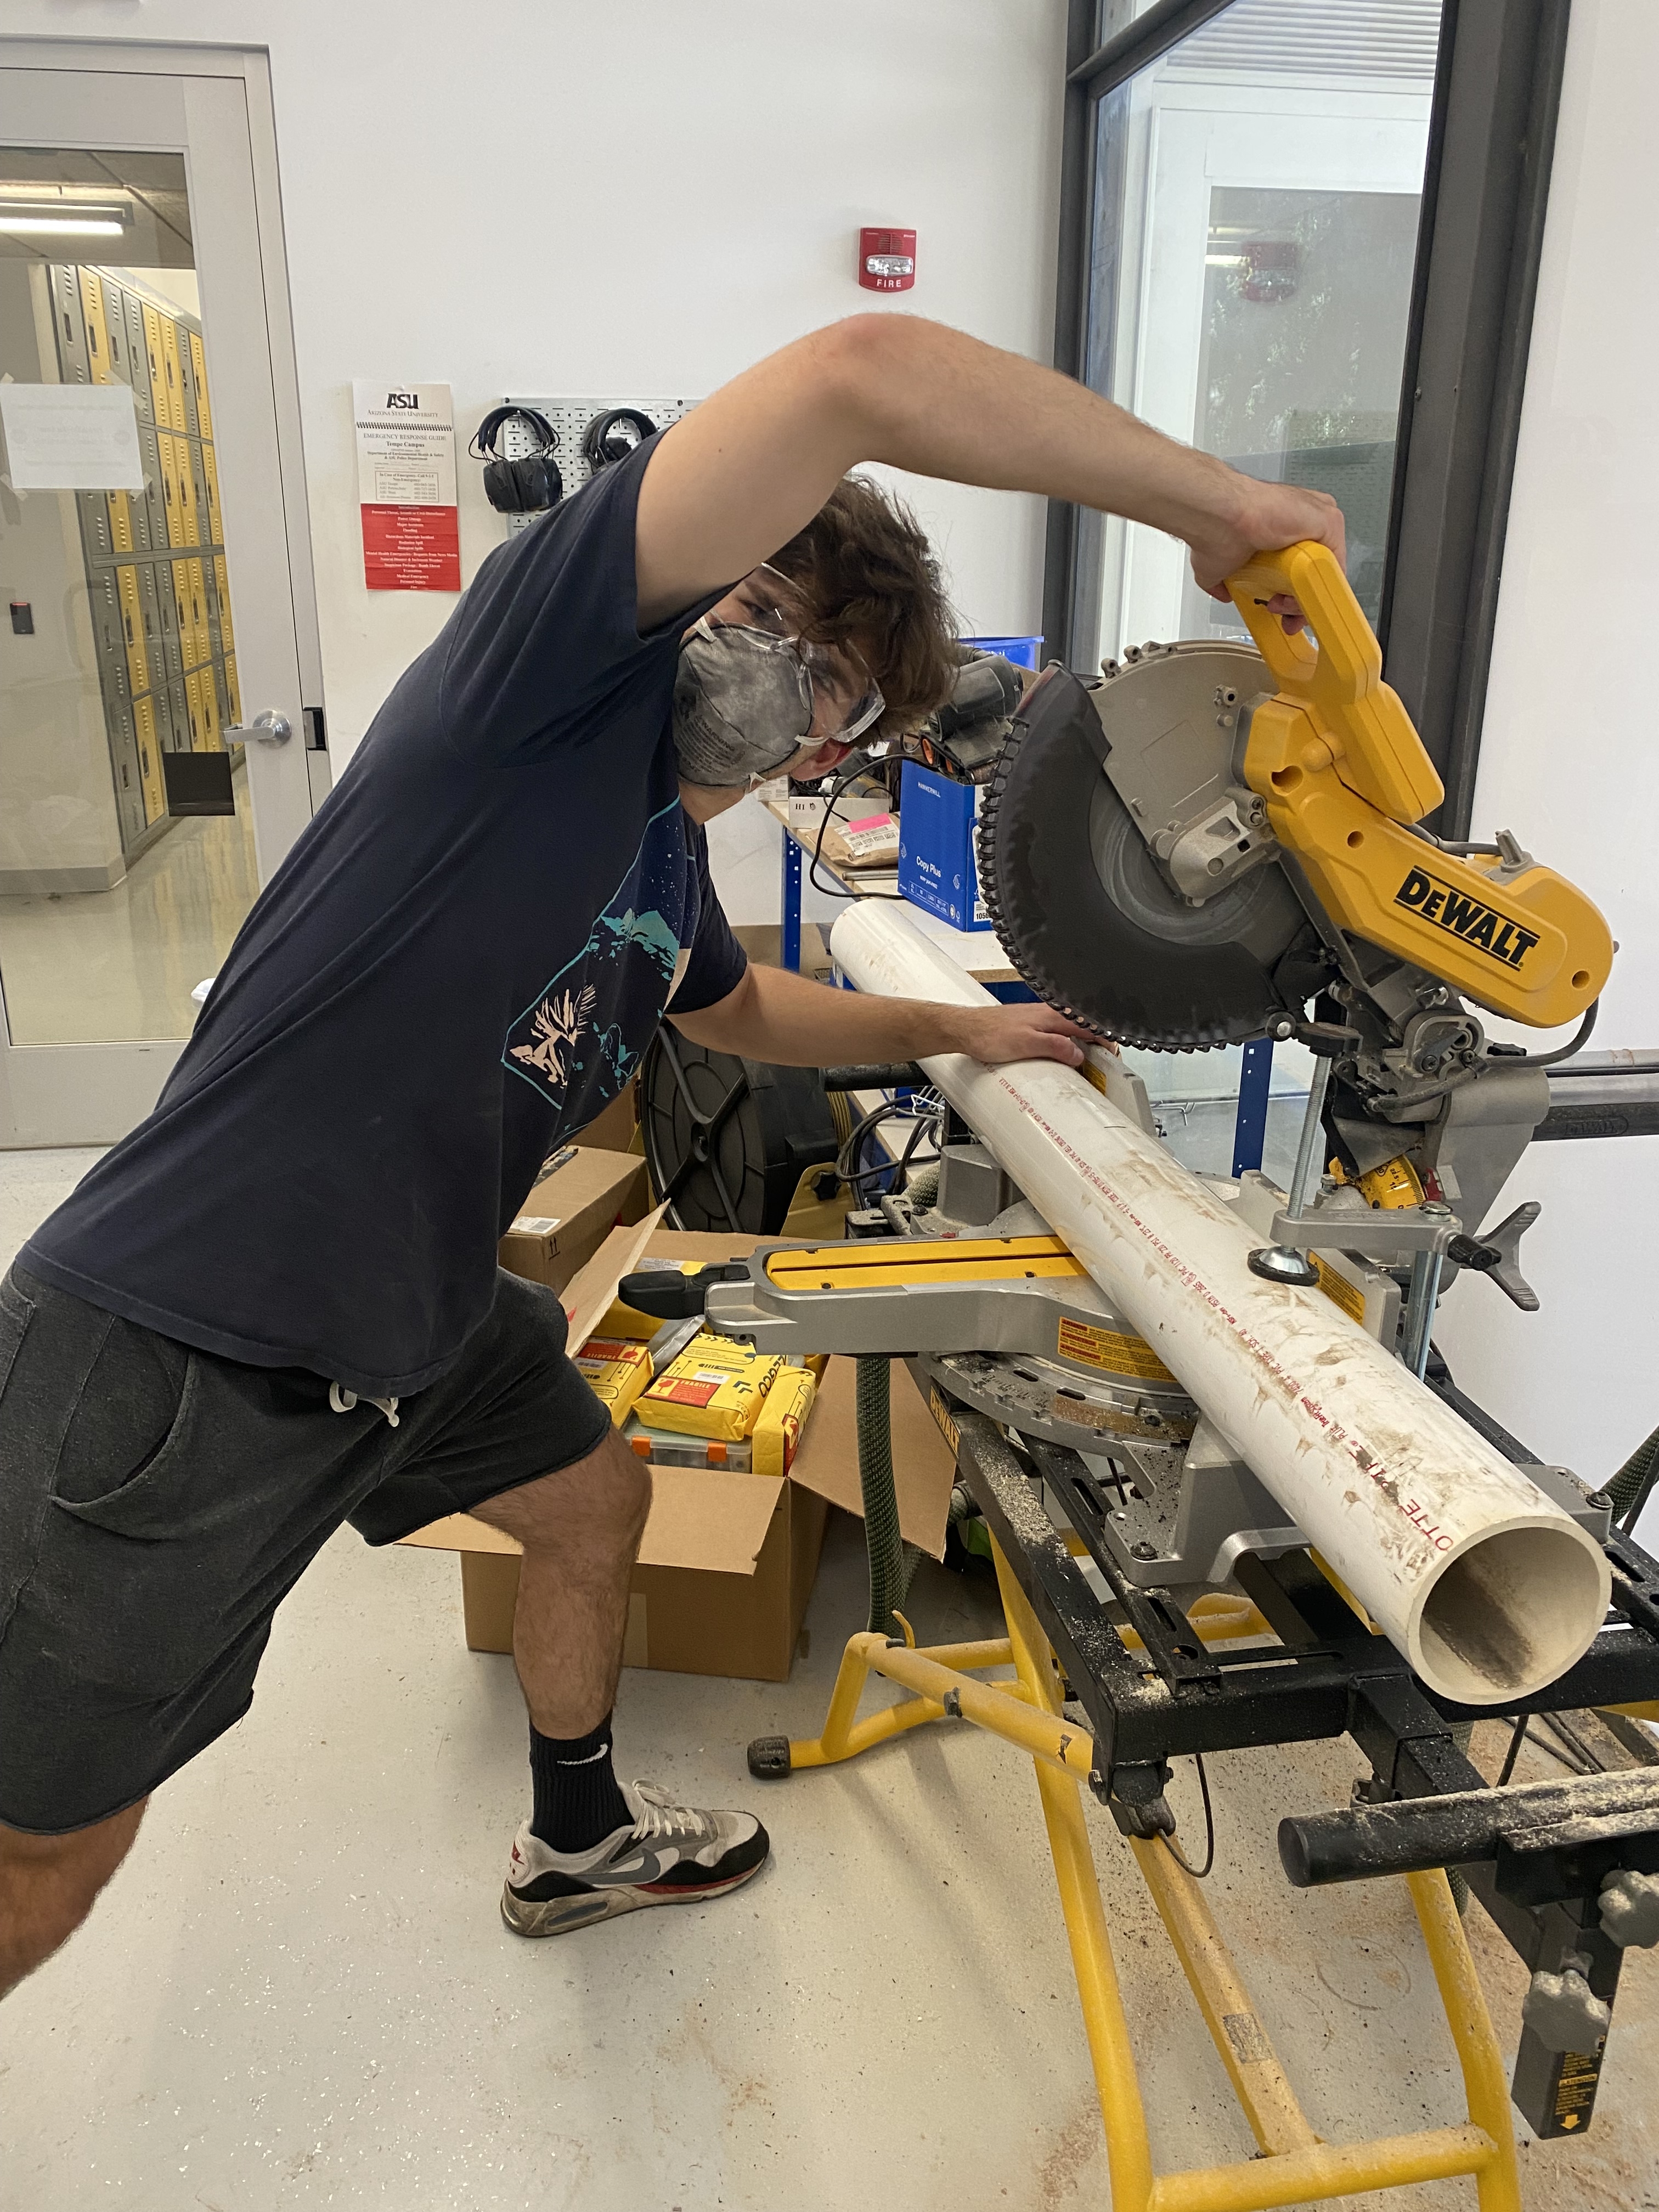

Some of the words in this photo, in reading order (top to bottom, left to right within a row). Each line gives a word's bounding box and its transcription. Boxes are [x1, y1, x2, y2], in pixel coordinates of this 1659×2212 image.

[877, 279, 901, 287] FIRE
[387, 393, 419, 409] ASU
[917, 856, 929, 872] Copy
[930, 864, 941, 877] Plus
[1150, 1237, 1160, 1246] PSI
[1158, 1244, 1167, 1253] 220
[1164, 1250, 1172, 1259] PR
[1170, 1256, 1181, 1267] 1120
[1178, 1265, 1188, 1276] PVC
[1193, 1280, 1206, 1293] 2665
[1206, 1294, 1219, 1307] ASTM
[1238, 1328, 1248, 1336] 40
[1260, 1350, 1274, 1364] TYPE
[1271, 1362, 1284, 1375] PVC
[680, 1380, 711, 1389] FRAGILE
[1288, 1379, 1303, 1394] 7400
